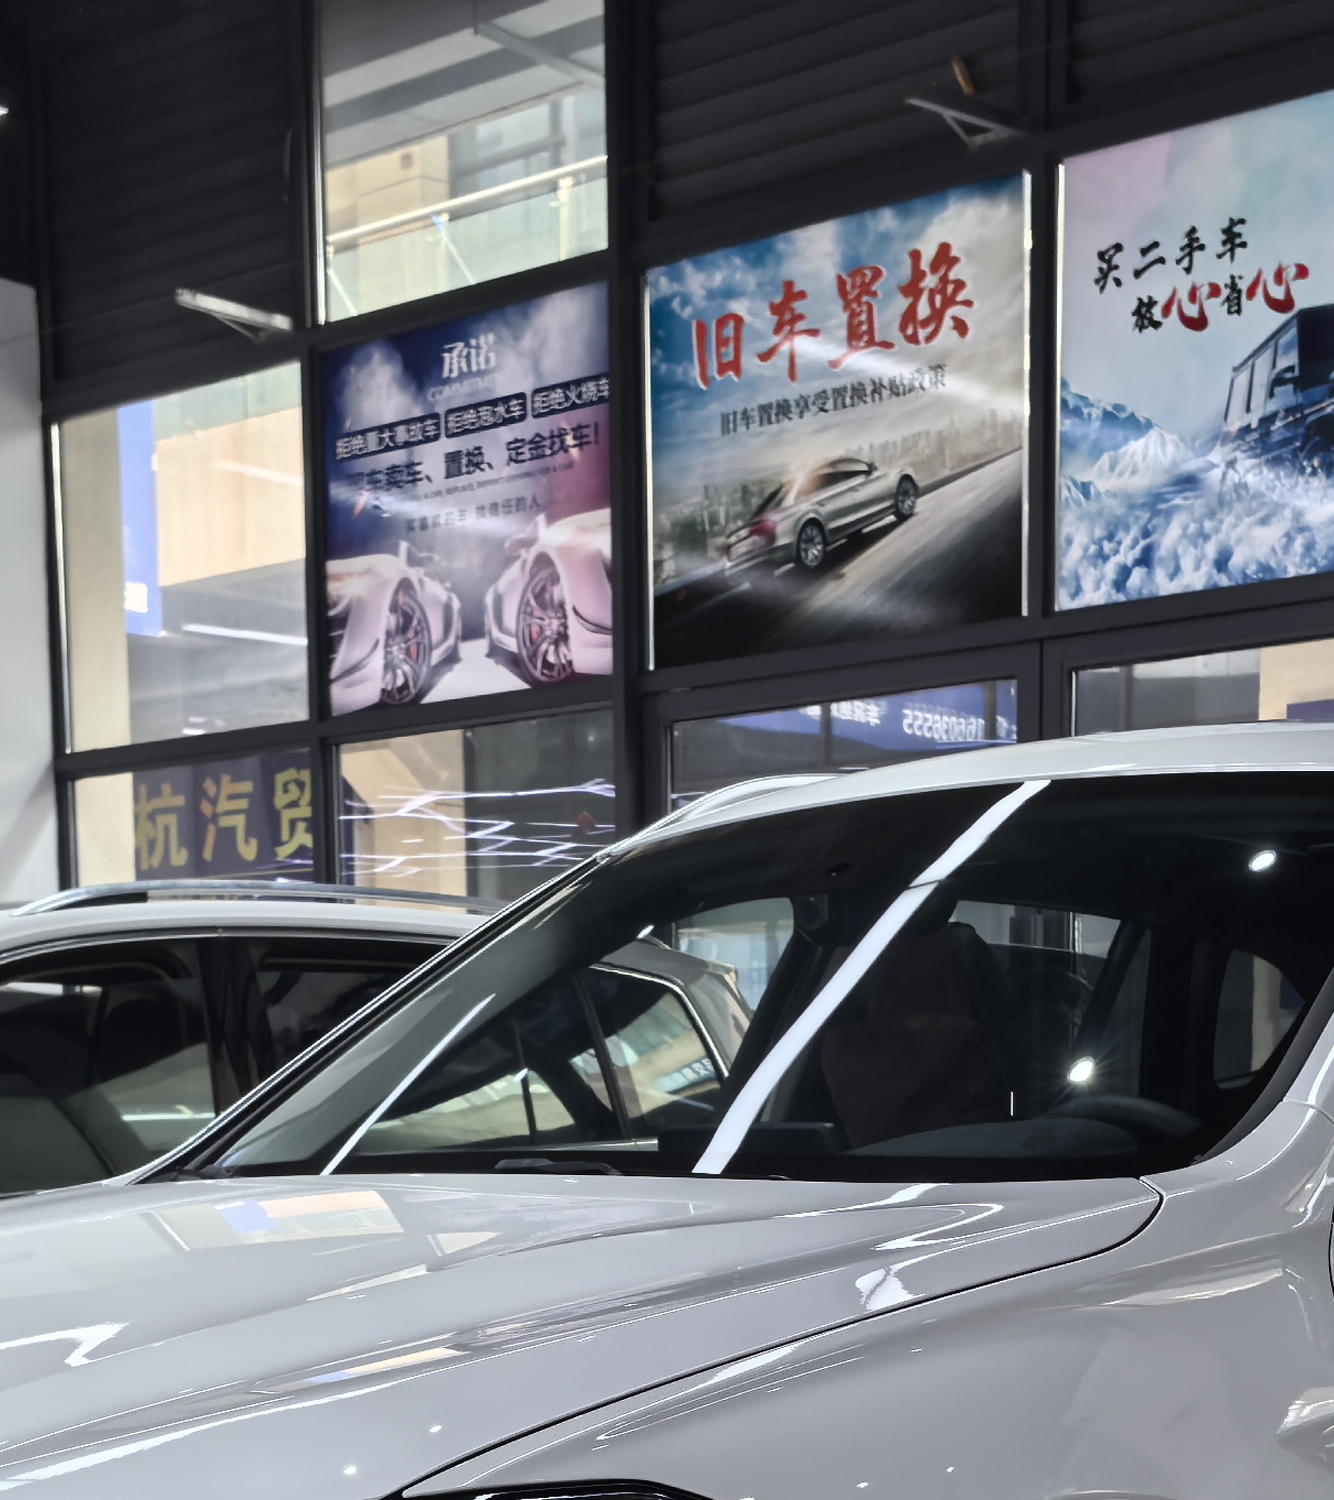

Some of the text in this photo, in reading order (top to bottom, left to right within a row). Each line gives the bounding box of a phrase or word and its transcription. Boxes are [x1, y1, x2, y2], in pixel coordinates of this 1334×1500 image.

[1094, 216, 1248, 293] 买二手车
[691, 241, 974, 390] 旧车置换
[1131, 262, 1309, 332] 放心省心
[441, 332, 497, 379] 承诺
